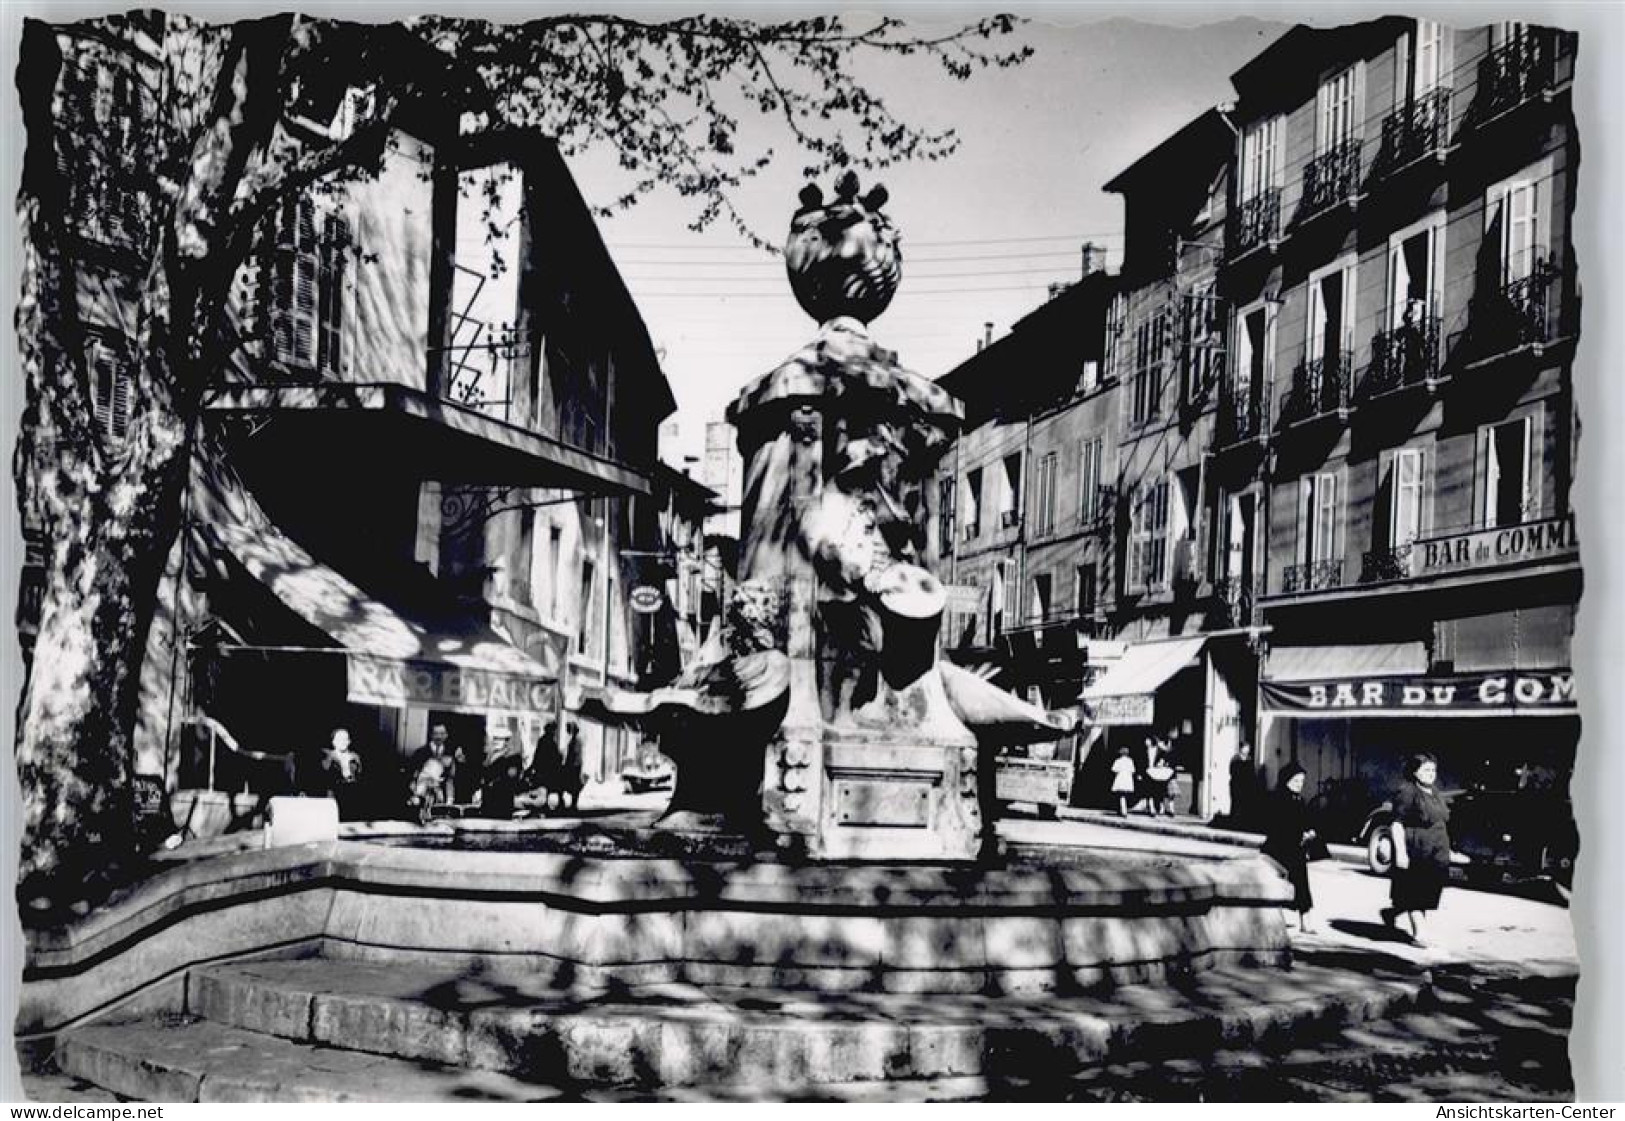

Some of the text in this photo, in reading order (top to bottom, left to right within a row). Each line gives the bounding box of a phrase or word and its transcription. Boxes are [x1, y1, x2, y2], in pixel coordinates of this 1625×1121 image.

[1425, 538, 1469, 567] BAR
[1475, 541, 1489, 561] du
[1309, 683, 1384, 708] BAR
[1403, 686, 1456, 706] DU
